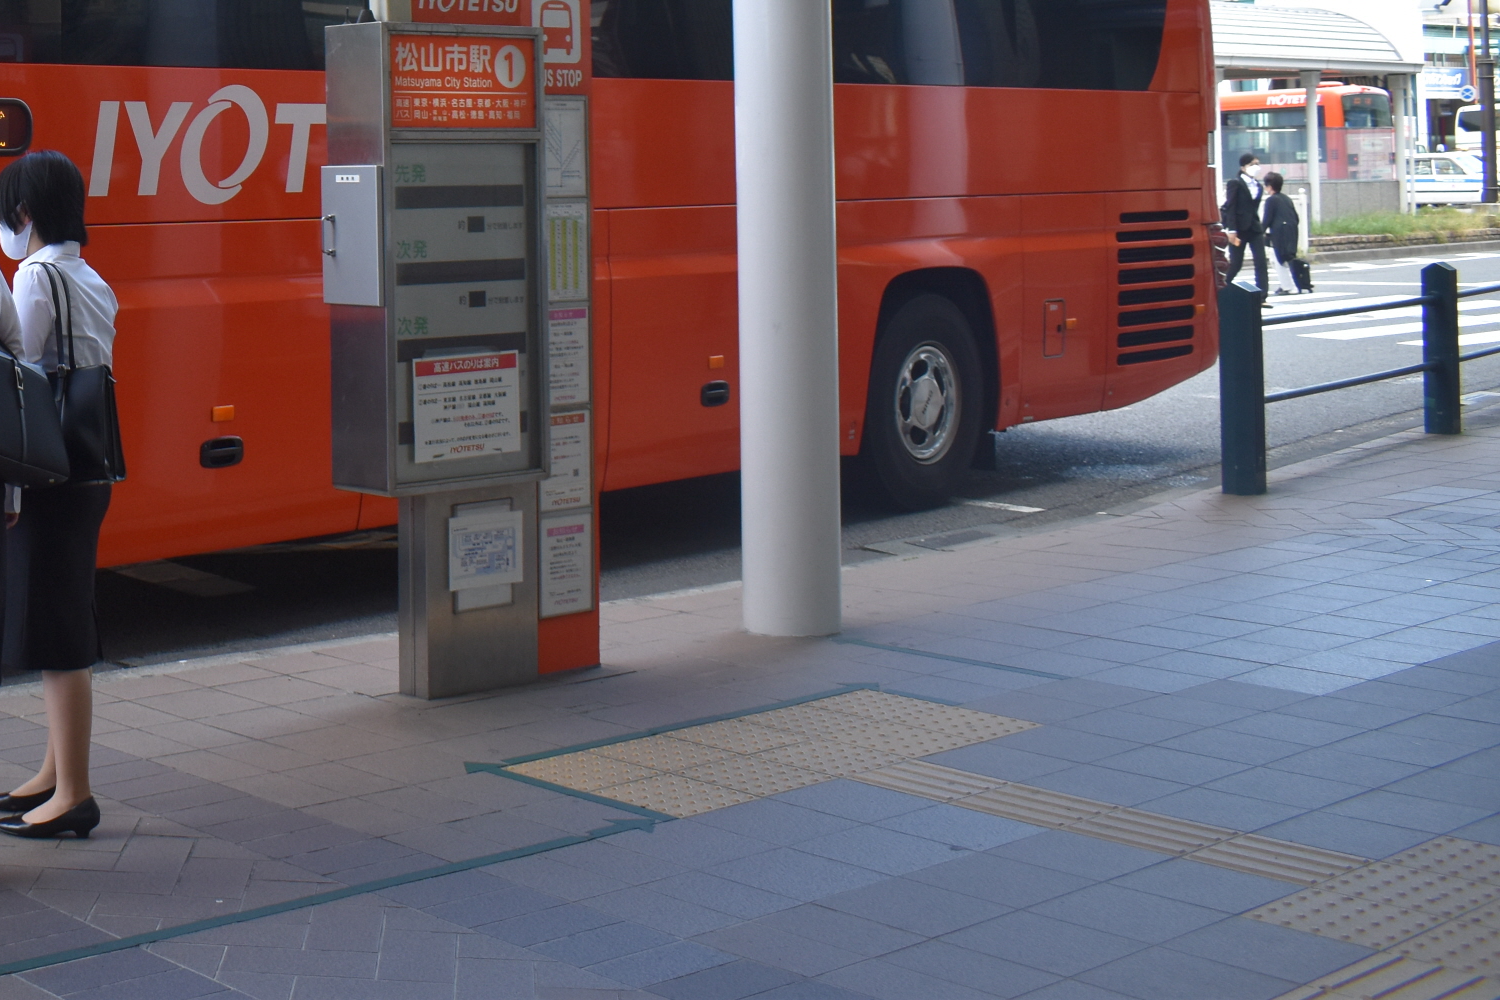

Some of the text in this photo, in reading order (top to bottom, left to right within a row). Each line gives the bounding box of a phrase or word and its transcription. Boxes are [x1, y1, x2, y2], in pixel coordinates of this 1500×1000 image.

[395, 42, 492, 73] 松山市駅
[395, 76, 493, 89] Matsuyama City Station
[556, 69, 582, 87] STOP
[1266, 94, 1322, 106] IYOTETU
[395, 163, 426, 184] 先発
[396, 239, 428, 260] 次発
[397, 315, 429, 336] 次発
[450, 443, 485, 454] IYOTETSU
